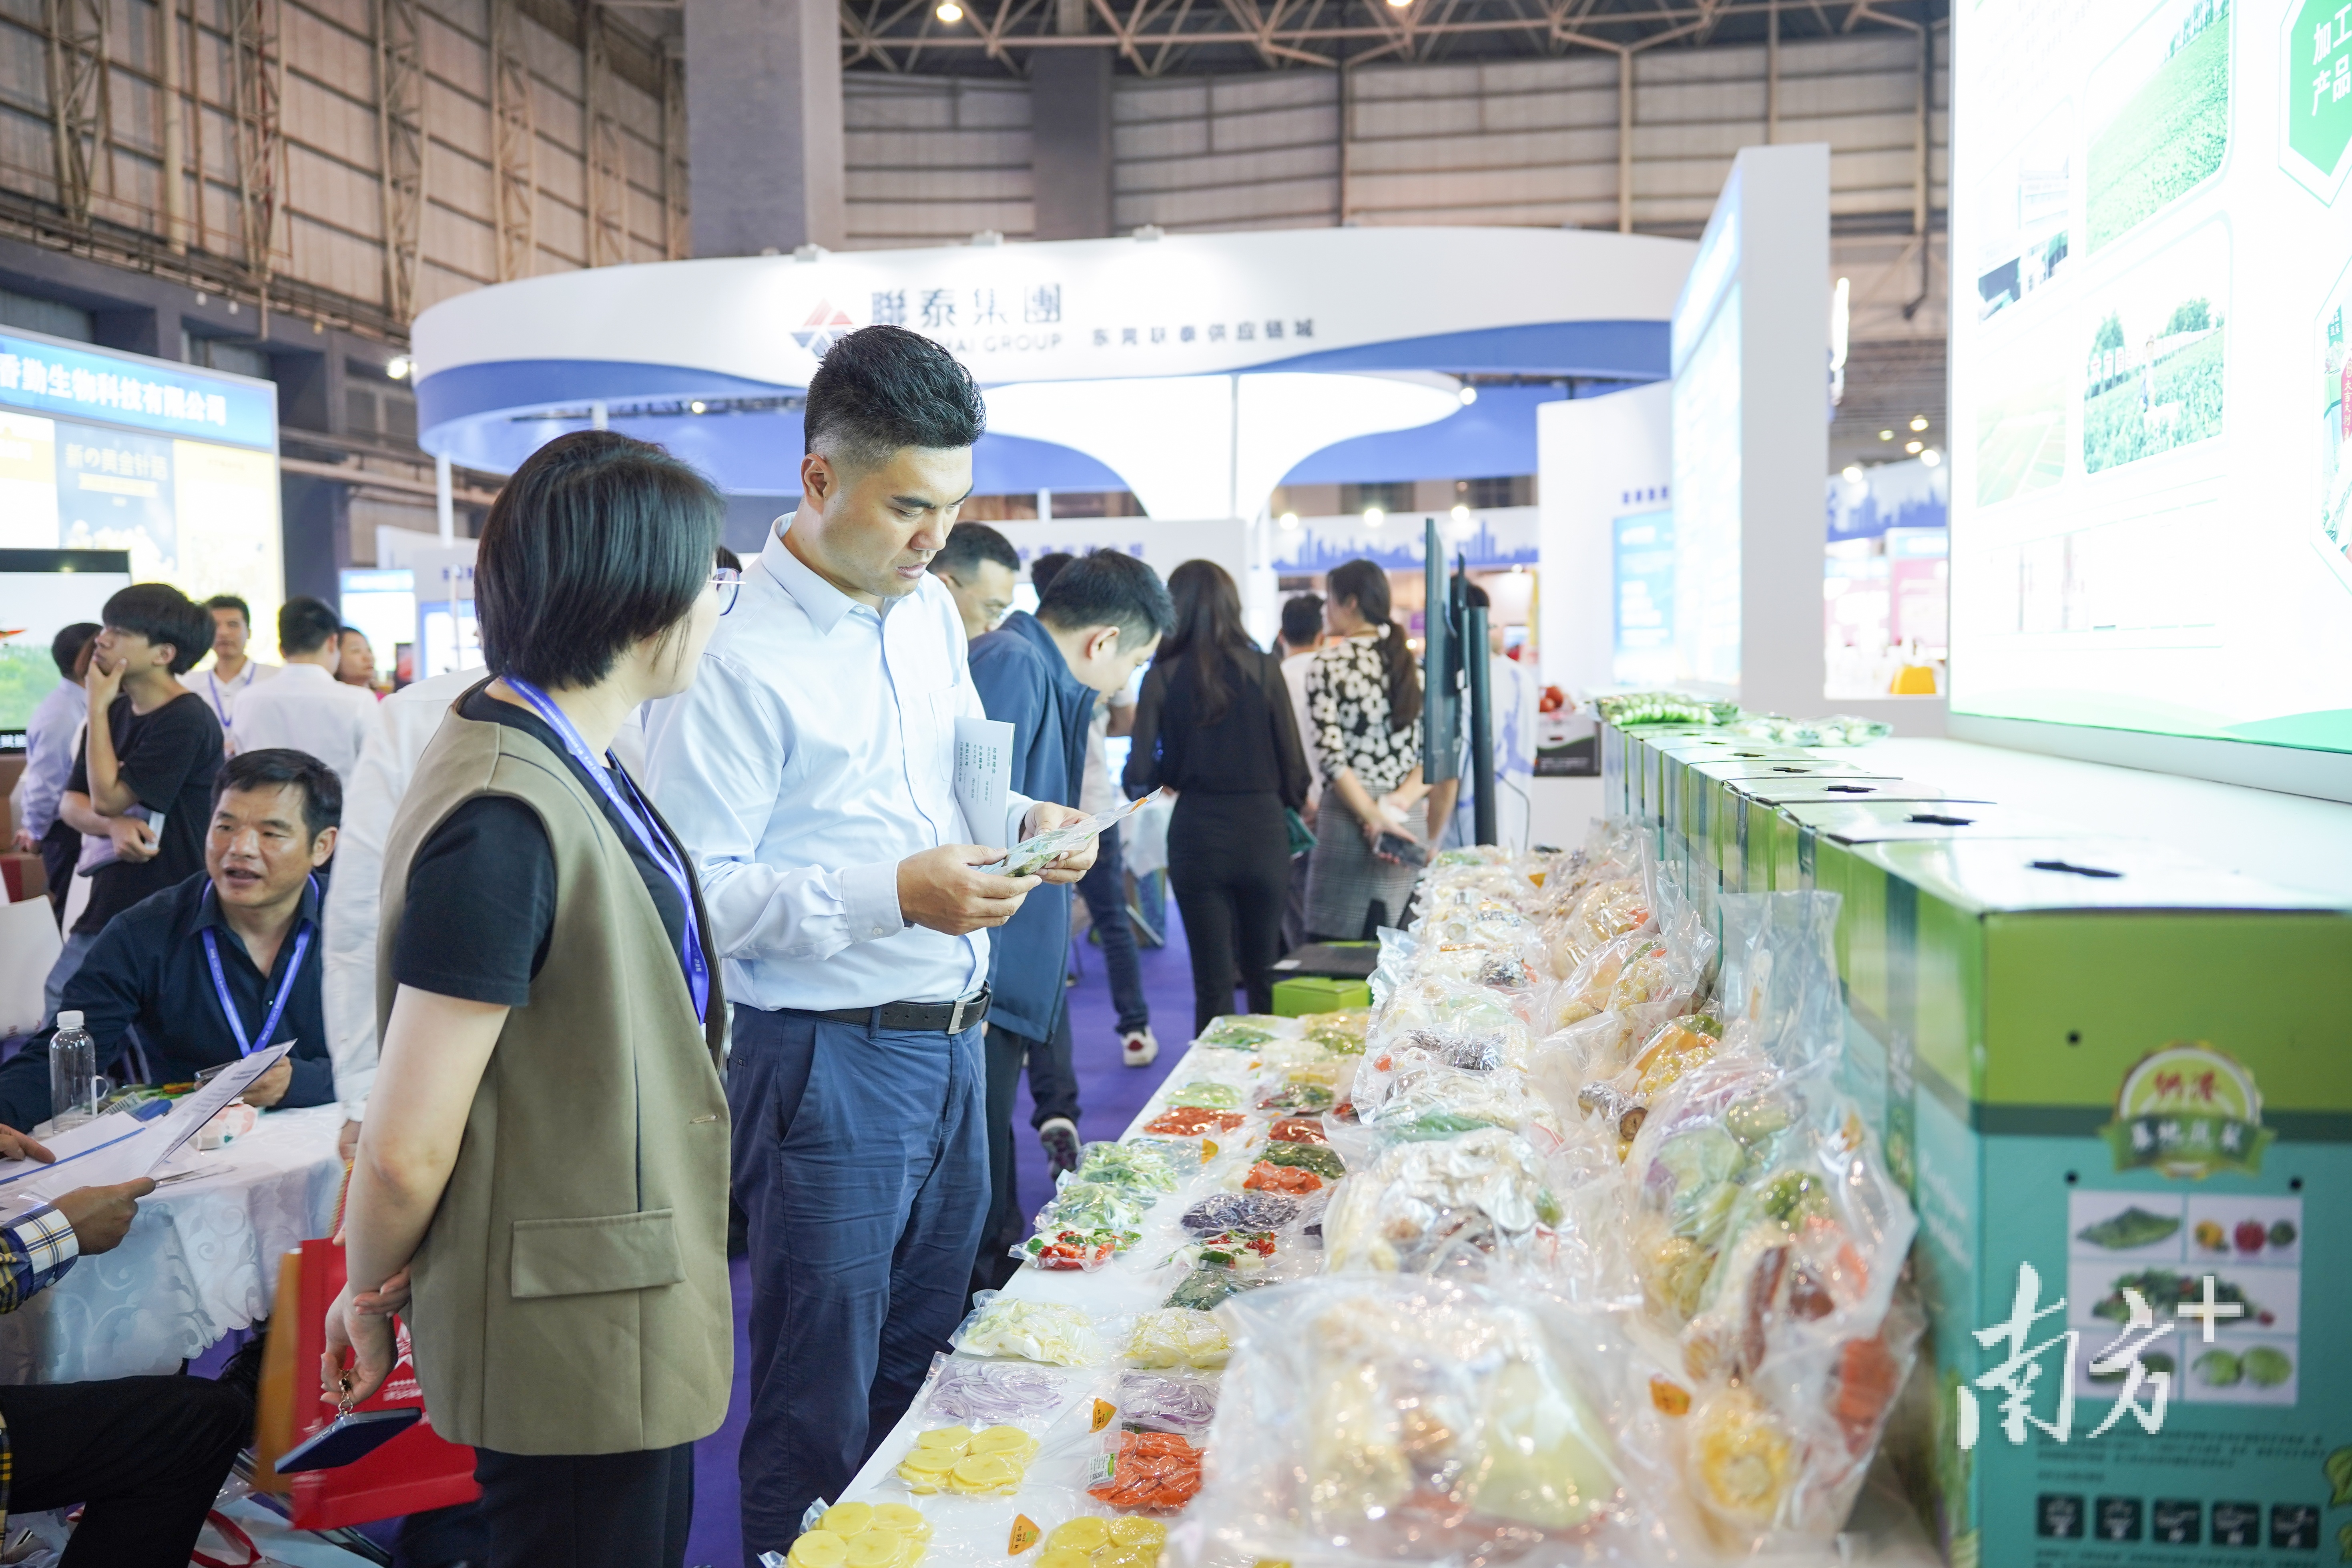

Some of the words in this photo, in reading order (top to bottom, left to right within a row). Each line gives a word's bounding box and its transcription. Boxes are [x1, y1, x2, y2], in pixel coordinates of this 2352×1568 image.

[2312, 2, 2352, 65] 加工
[2312, 54, 2351, 116] 产品
[983, 333, 1062, 352] GROUP
